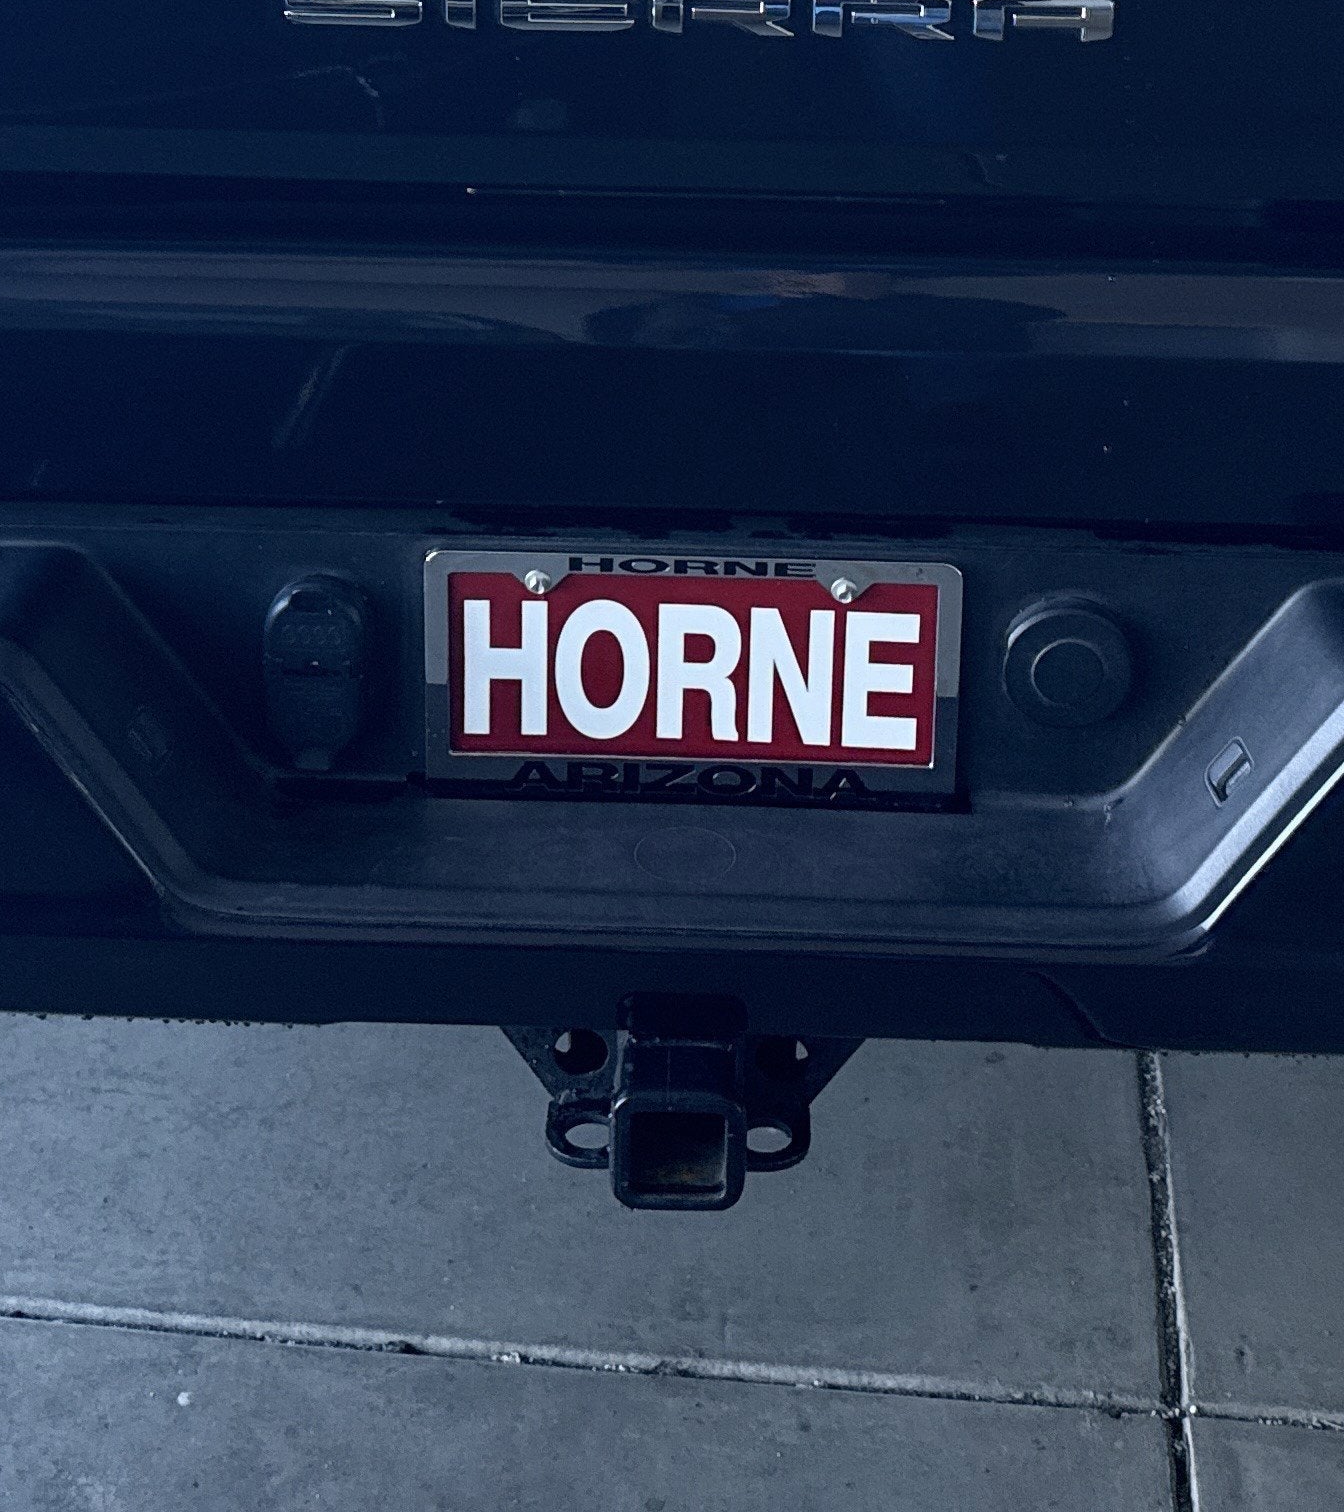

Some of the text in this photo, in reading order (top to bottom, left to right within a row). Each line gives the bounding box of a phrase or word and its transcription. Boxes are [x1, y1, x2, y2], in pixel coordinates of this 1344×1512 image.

[567, 555, 818, 579] HORNE
[462, 598, 921, 752] HORNE
[508, 759, 871, 799] ARIZONA
